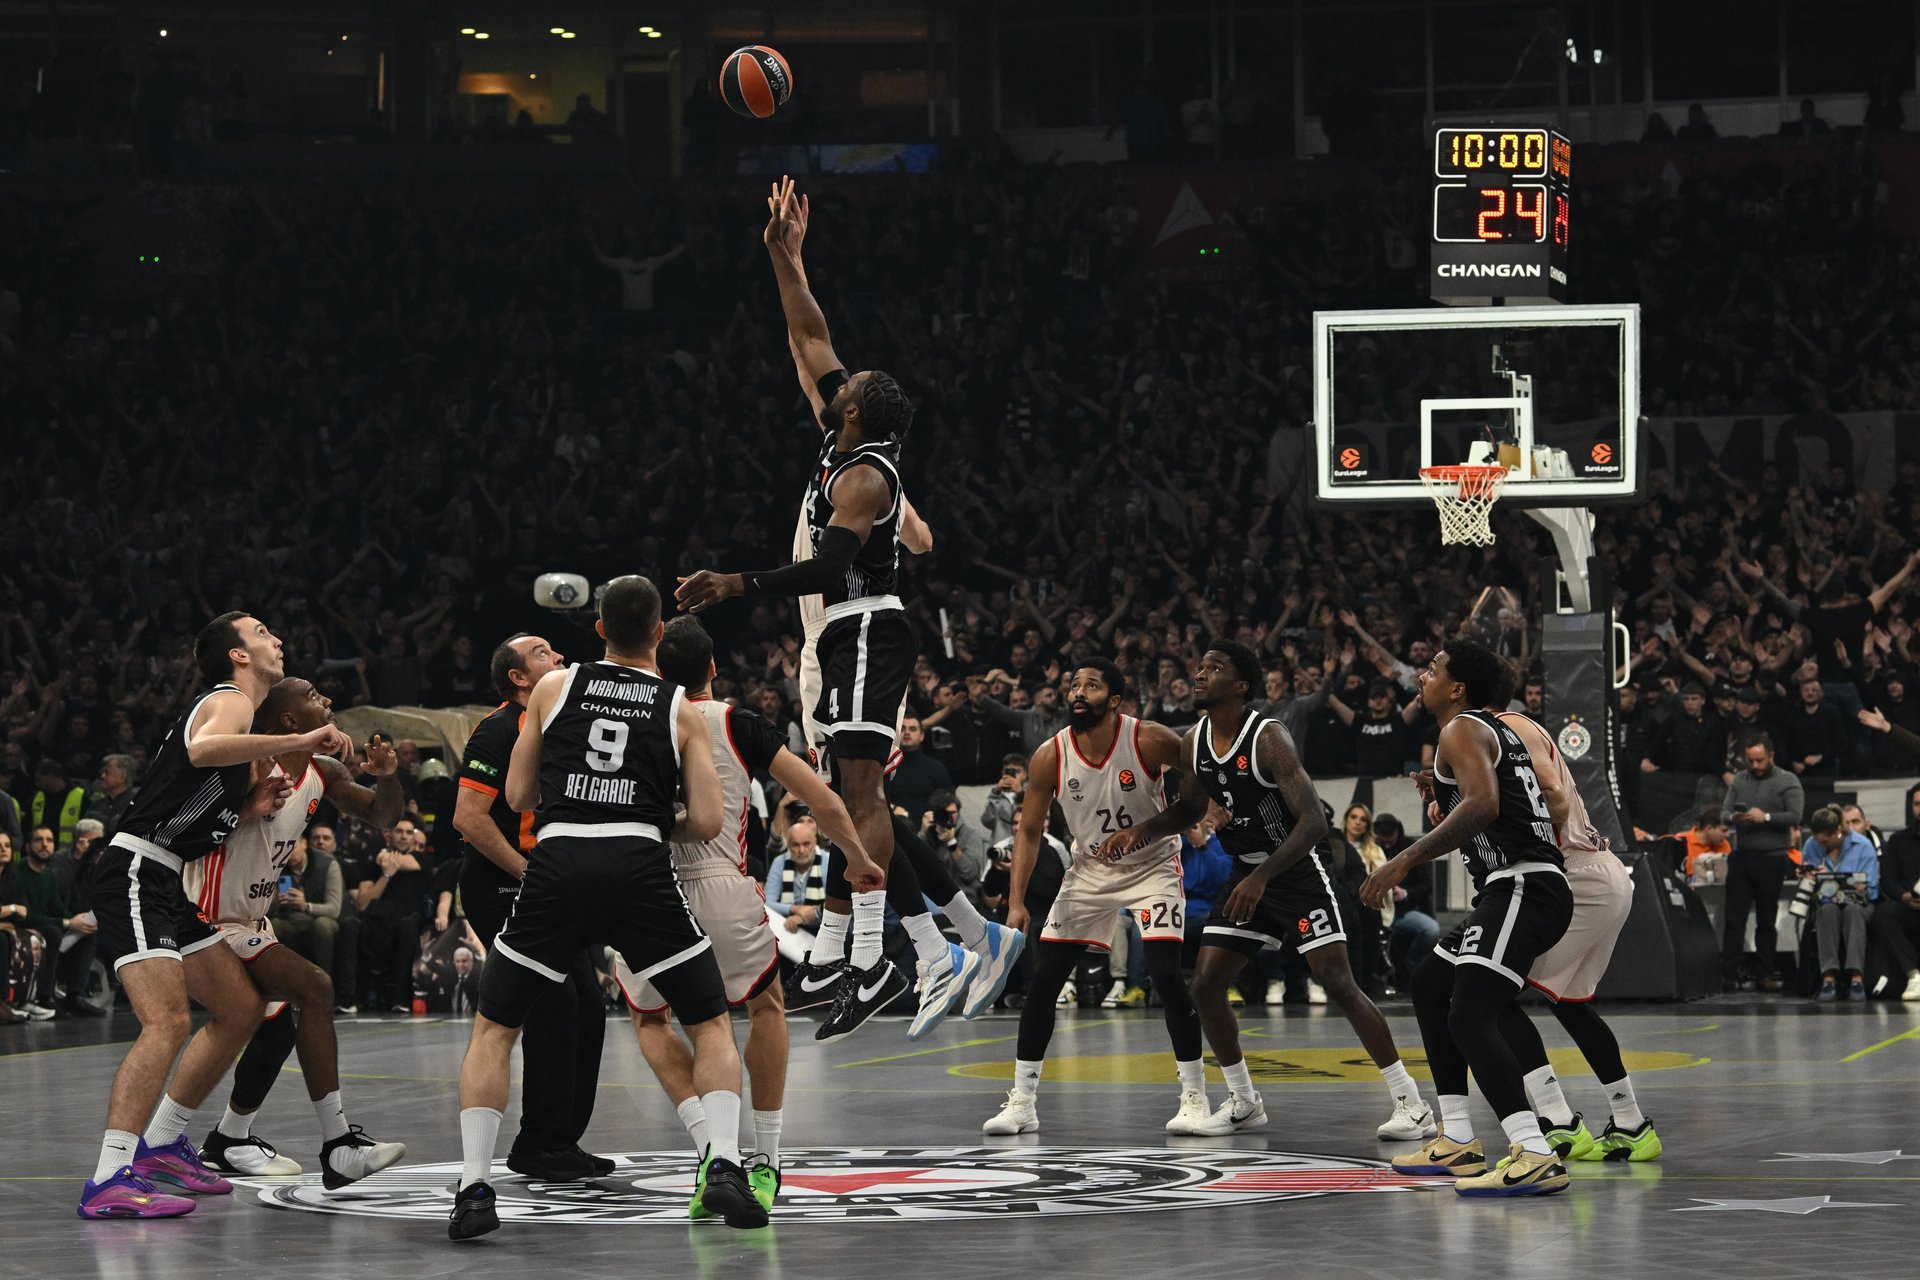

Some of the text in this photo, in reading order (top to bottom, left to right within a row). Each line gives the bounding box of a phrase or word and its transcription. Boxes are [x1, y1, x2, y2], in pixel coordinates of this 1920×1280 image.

[1452, 134, 1543, 168] 10:00
[1478, 190, 1543, 238] 24
[1437, 264, 1541, 277] CHANGAN
[584, 679, 660, 705] MARINKOVIĆ
[829, 687, 840, 719] 4
[581, 702, 652, 720] CHANGAN
[585, 718, 630, 773] 9
[564, 773, 638, 805] BELGRADE
[1514, 765, 1551, 819] 12
[1096, 805, 1134, 834] 26
[271, 840, 296, 870] 22
[1152, 902, 1183, 929] 26
[1308, 908, 1333, 938] 2
